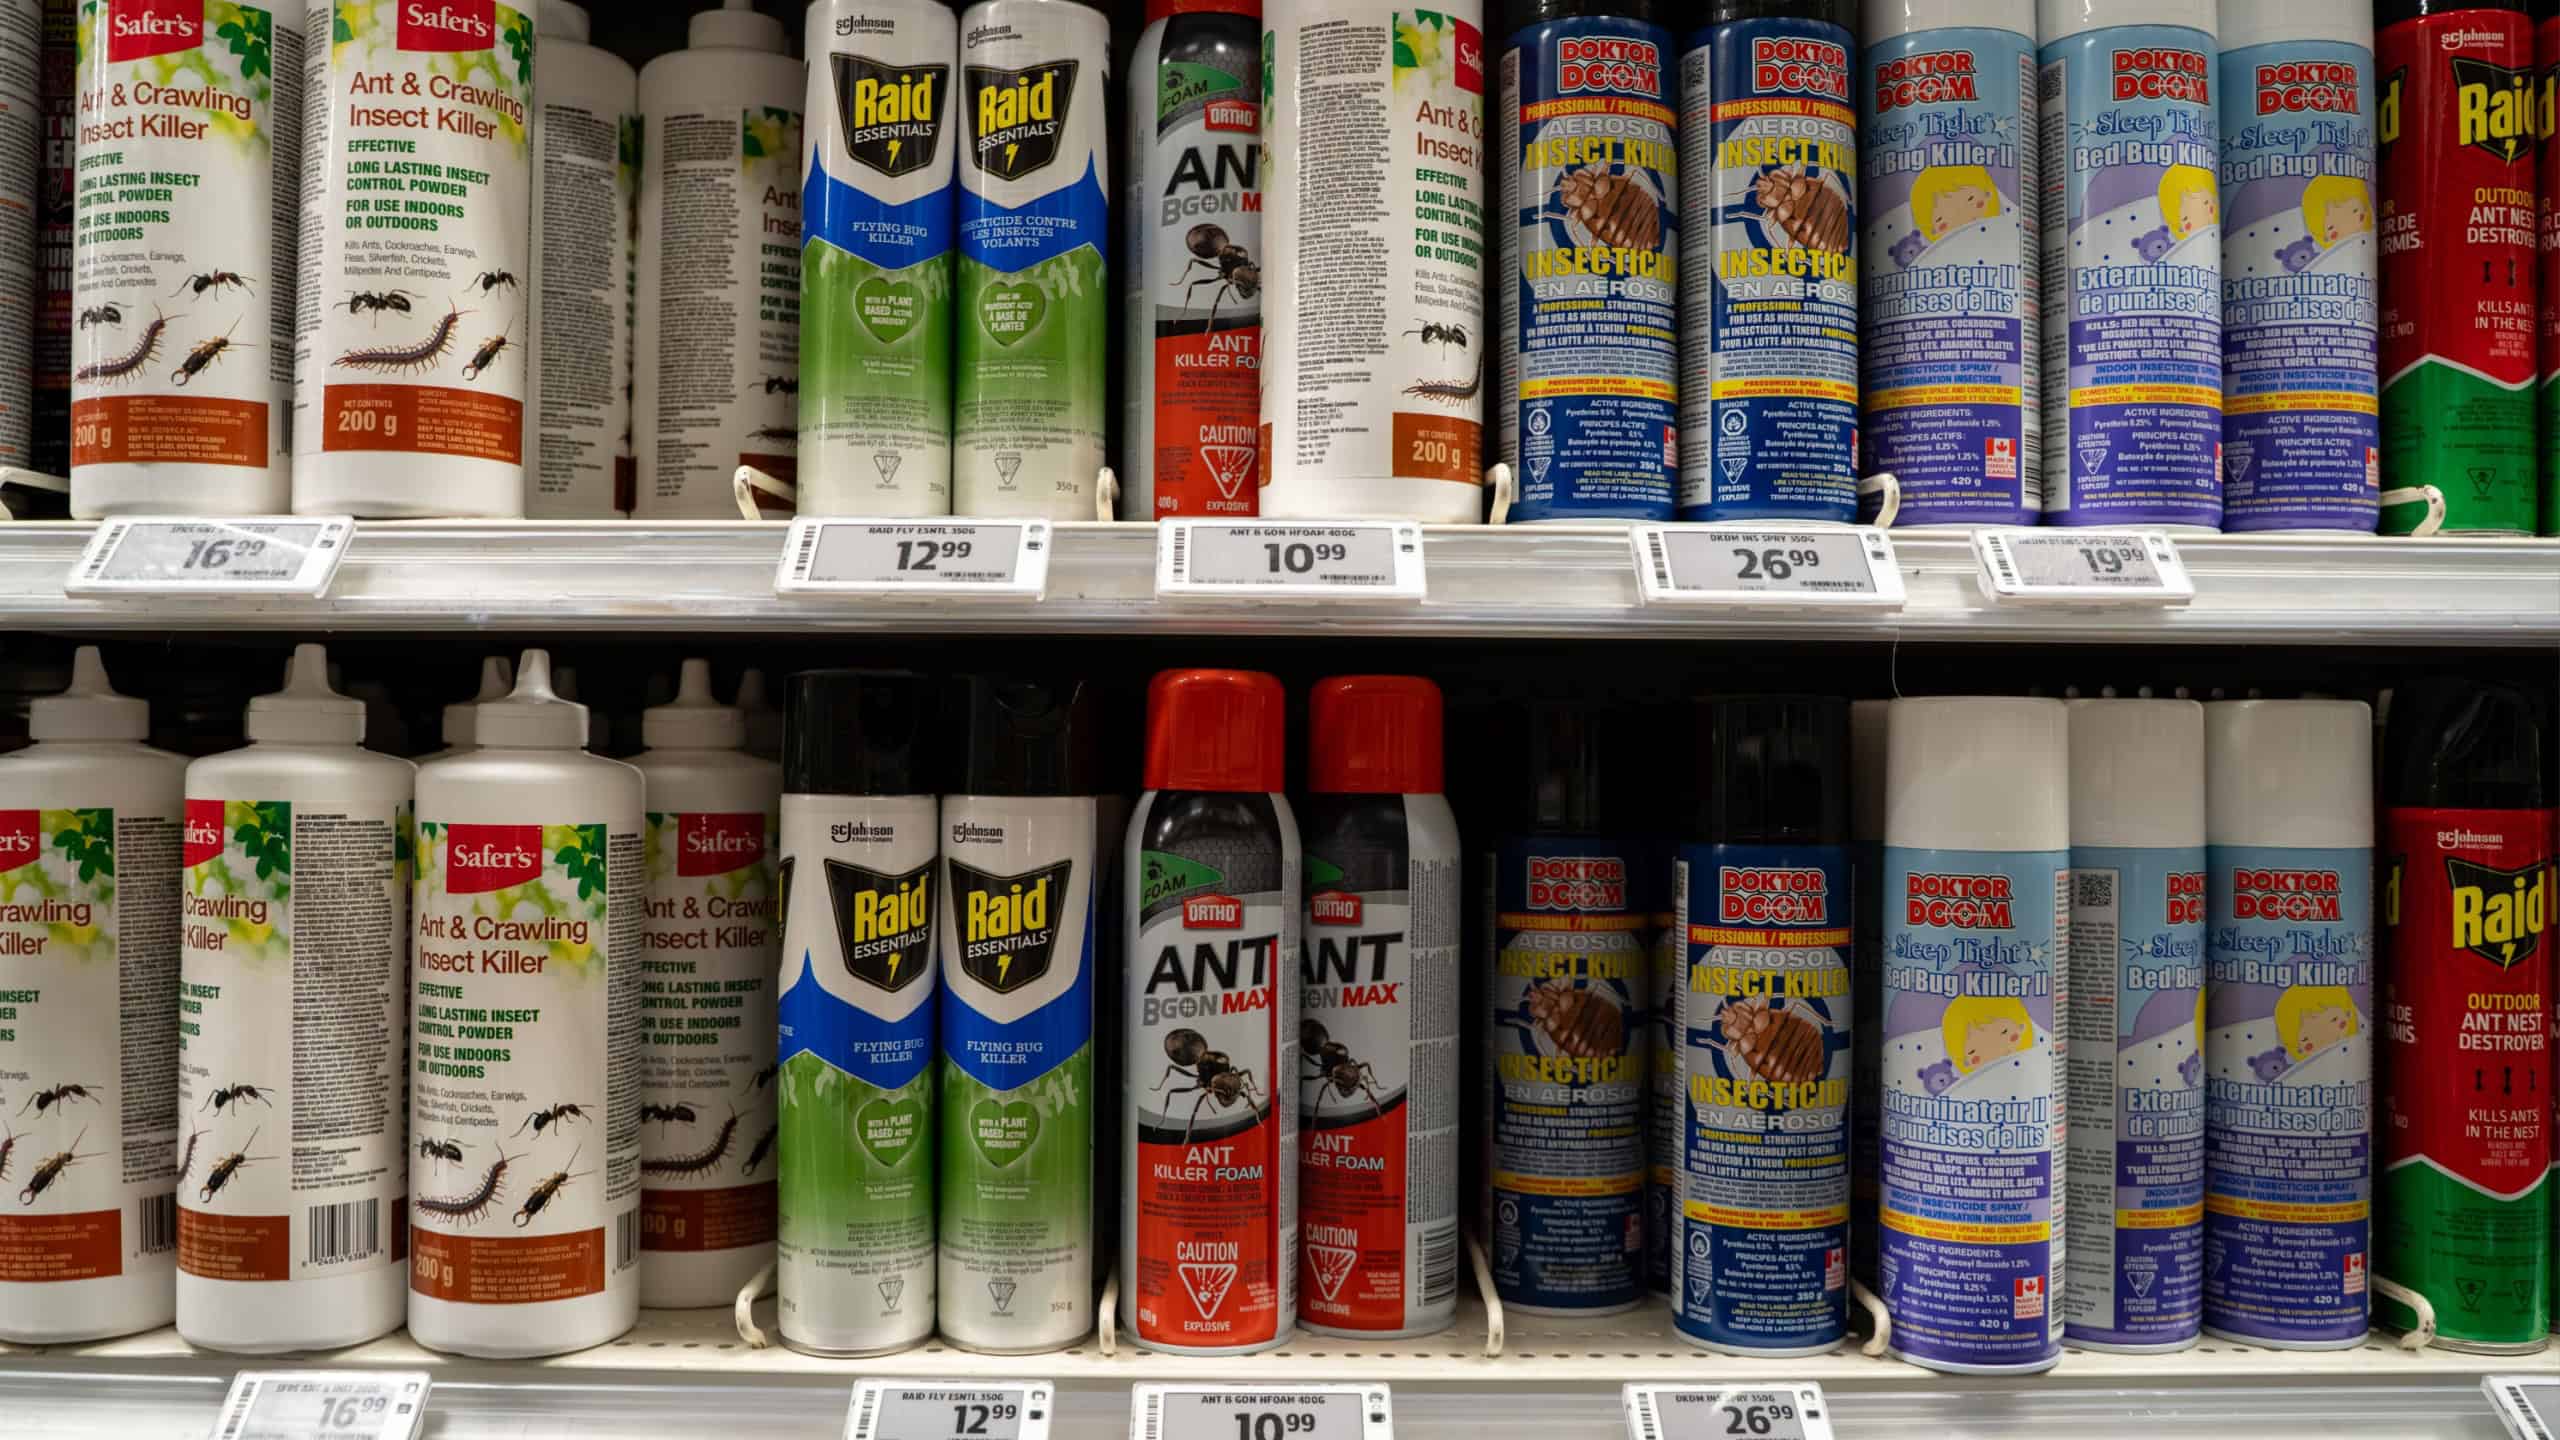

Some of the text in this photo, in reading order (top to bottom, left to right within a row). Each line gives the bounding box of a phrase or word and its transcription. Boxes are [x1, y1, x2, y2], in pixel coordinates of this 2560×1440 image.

[114, 11, 194, 38] Safer's
[407, 3, 488, 38] Safer's
[1561, 41, 1658, 66] DOKTOR
[1757, 40, 1845, 68] DOKTOR
[2113, 50, 2208, 77] DOKTOR
[2256, 61, 2358, 85] DOKTOR
[111, 81, 251, 120] & Crawling
[350, 71, 523, 125] Ant & Crawling
[855, 73, 933, 129] Raid
[978, 71, 1053, 138] Raid
[1162, 79, 1209, 111] FOAM
[1210, 106, 1254, 126] ORTHO
[1416, 101, 1453, 129] Ant
[1526, 98, 1607, 120] PROFESSIONAL
[1717, 98, 1804, 119] PROFESSIONAL
[141, 113, 209, 140] Killer
[350, 104, 498, 141] Insect Killer
[2096, 109, 2164, 140] Sleep
[854, 123, 934, 144] ESSENTIALS
[2240, 123, 2309, 153] Sleep
[347, 139, 416, 154] EFFECTIVE
[1930, 141, 1995, 167] Killer
[2074, 140, 2175, 173] Bed Bug
[99, 172, 200, 188] LASTING INSECT
[347, 161, 491, 185] LONG LASTING INSECT
[1416, 168, 1467, 191] EFFECTIVE
[119, 189, 173, 202] POWDER
[346, 178, 467, 197] CONTROL POWDER
[1416, 190, 1445, 206] LONG
[114, 210, 170, 224] INDOORS
[346, 199, 465, 218] FOR USE INDOORS
[1415, 206, 1463, 226] CONTROL
[2469, 206, 2506, 225] ANT
[345, 216, 438, 231] OR OUTDOORS
[852, 221, 928, 238] FLYING BUG
[992, 227, 1053, 239] INSECTES
[1026, 217, 1077, 230] CONTRE
[868, 232, 914, 246] KILLER
[982, 237, 1041, 249] VOLANTS
[1415, 228, 1459, 247] FOR USE
[1415, 245, 1432, 258] OR
[1533, 280, 1566, 297] EN
[1728, 283, 1761, 299] EN
[1954, 289, 2013, 313] de lits
[2079, 289, 2194, 315] de punaises
[2477, 300, 2512, 314] KILLS
[1580, 312, 1627, 322] HOUSEHOLD
[2475, 316, 2515, 330] IN THE
[1207, 335, 1252, 352] ANT
[1175, 354, 1230, 368] KILLER
[1590, 399, 1618, 409] ACTIVE
[2123, 408, 2157, 417] ACTIVE
[338, 410, 398, 436] 200 g
[102, 426, 112, 449] g
[1200, 425, 1257, 444] CAUTION
[1413, 440, 1461, 466] 200 g
[1951, 476, 1972, 486] 420
[868, 526, 914, 535] RAID FLY
[1230, 527, 1251, 537] ANT
[453, 843, 533, 869] Safer's
[1143, 875, 1186, 904] FOAM
[1724, 871, 1825, 894] DOKTOR
[853, 874, 927, 943] Raid
[967, 877, 1047, 943] Raid
[1187, 902, 1235, 922] ORTHO
[1313, 900, 1353, 918] ORTHO
[2452, 870, 2545, 949] Raid
[187, 928, 228, 951] Killer
[1710, 949, 1835, 968] AEROSOL
[1896, 932, 2020, 971] Sleep Tight
[1144, 932, 1279, 995] ANT
[1221, 985, 1273, 1016] MAX
[1341, 982, 1400, 1009] MAX
[2468, 992, 2541, 1011] OUTDOOR
[439, 1006, 487, 1022] LASTING
[2461, 1012, 2544, 1032] ANT NEST
[458, 1025, 514, 1040] POWDER
[2459, 1032, 2545, 1051] DESTROYER
[453, 1046, 511, 1061] INDOORS
[853, 1038, 925, 1053] FLYING BUG
[966, 1039, 1043, 1053] FLYING BUG
[870, 1050, 913, 1065] KILLER
[980, 1052, 1027, 1064] KILLER
[428, 1063, 485, 1079] OUTDOORS
[1000, 1117, 1027, 1129] PLANT
[1696, 1109, 1843, 1131] EN AEROSOL
[2469, 1109, 2540, 1124] KILLS ANTS
[978, 1127, 1004, 1139] BASED
[1764, 1134, 1806, 1146] STRENGTH
[1986, 1125, 2045, 1150] de lits
[2465, 1123, 2540, 1140] IN THE NEST
[1311, 1133, 1354, 1153] ANT
[1787, 1144, 1806, 1155] PEST
[1184, 1146, 1235, 1165] ANT
[1335, 1155, 1384, 1171] FOAM
[1215, 1165, 1263, 1181] FOAM
[1965, 1166, 2025, 1177] ANTS AND FLIES
[1924, 1198, 2023, 1212] INSECTICIDE SPRAY
[1306, 1223, 1358, 1247] CAUTION
[1176, 1241, 1239, 1261] CAUTION
[1310, 1300, 1351, 1315] EXPLOSIVE
[1184, 1320, 1231, 1333] EXPLOSIVE
[1978, 1319, 2000, 1329] 420
[902, 1392, 978, 1402] RAID FLY ESNTL
[1235, 1395, 1257, 1405] GON
